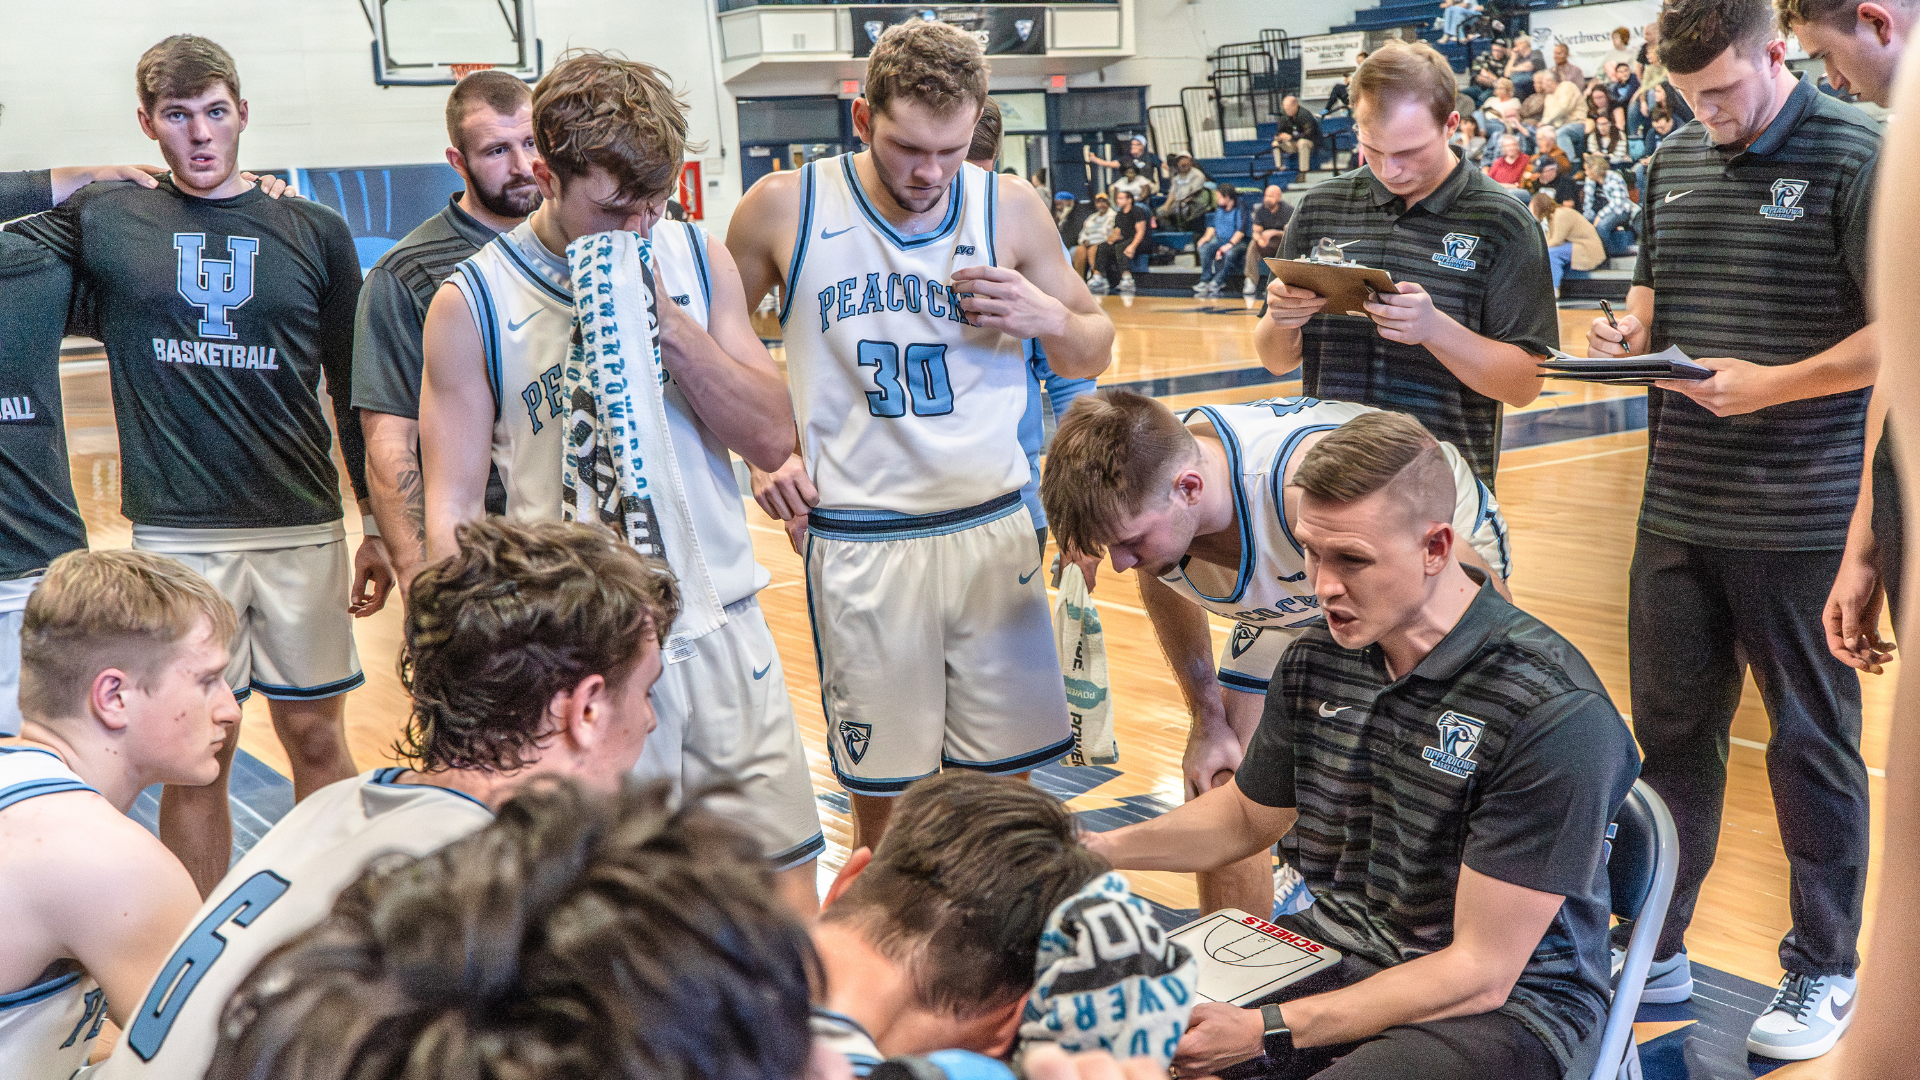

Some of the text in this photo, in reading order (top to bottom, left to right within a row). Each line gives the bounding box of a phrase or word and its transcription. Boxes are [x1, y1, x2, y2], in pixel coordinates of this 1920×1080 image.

[1553, 31, 1611, 45] Northwest
[818, 272, 976, 334] PEACOCK
[152, 338, 279, 370] BASKETBALL
[857, 339, 954, 417] 30
[0, 396, 36, 420] ALL
[1242, 916, 1325, 953] SCHEELS
[128, 869, 292, 1063] 6
